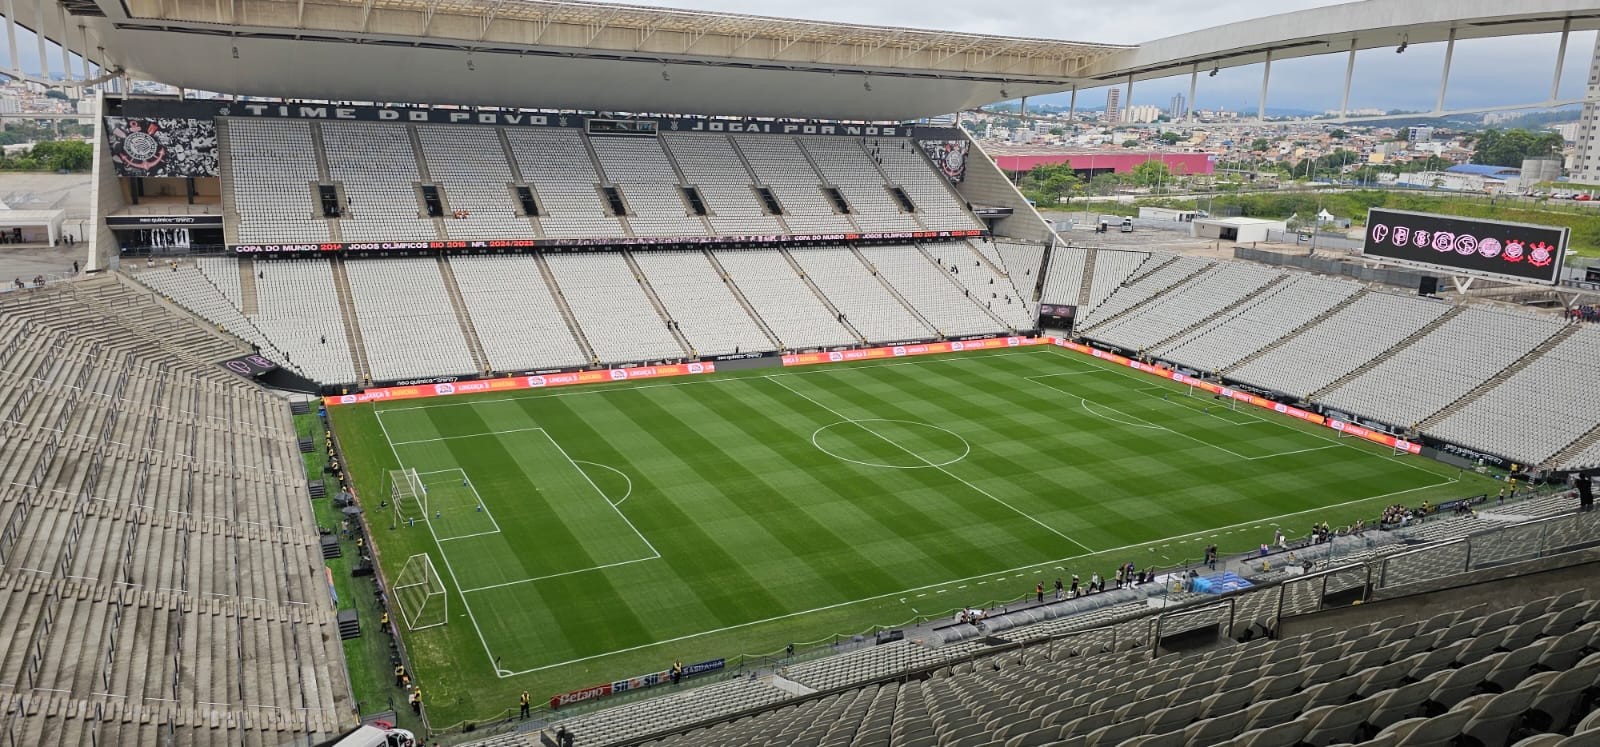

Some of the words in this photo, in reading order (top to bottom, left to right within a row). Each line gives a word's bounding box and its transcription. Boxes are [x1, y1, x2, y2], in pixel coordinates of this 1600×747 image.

[245, 104, 356, 118] TIME
[378, 109, 428, 121] DO
[450, 112, 548, 125] POVO
[691, 122, 770, 132] JOGAI
[784, 125, 835, 134] POR
[560, 687, 603, 705] Betano
